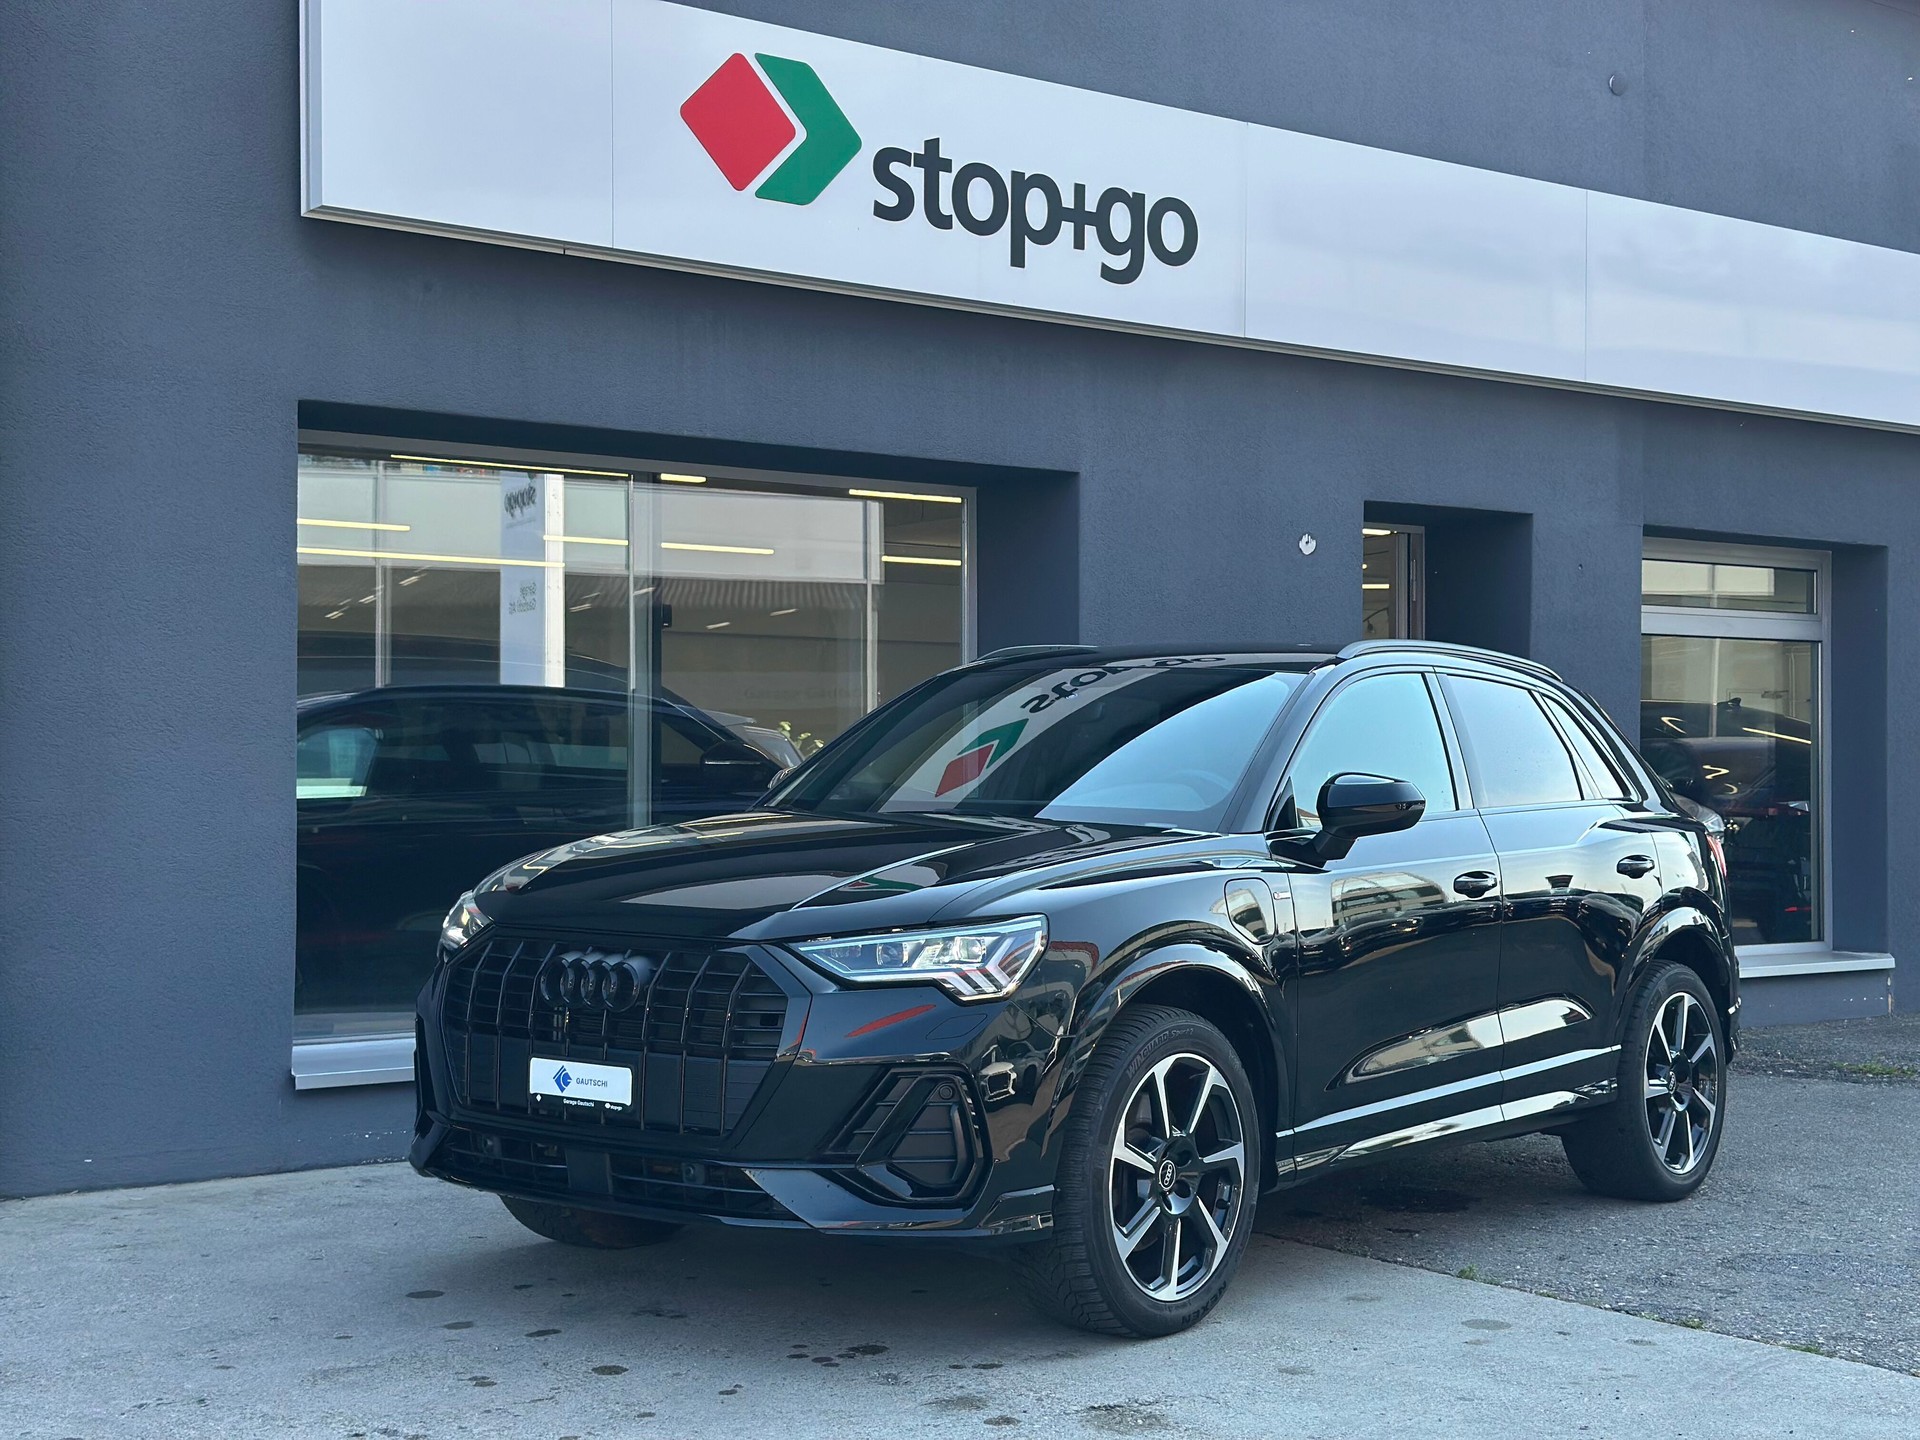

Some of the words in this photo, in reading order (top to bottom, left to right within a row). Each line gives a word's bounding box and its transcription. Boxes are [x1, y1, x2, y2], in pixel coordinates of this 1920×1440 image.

[872, 136, 1199, 285] stop+go
[1126, 1030, 1169, 1079] WINGUARD
[575, 1077, 608, 1088] GAUTSCHI
[563, 1098, 577, 1106] Garage
